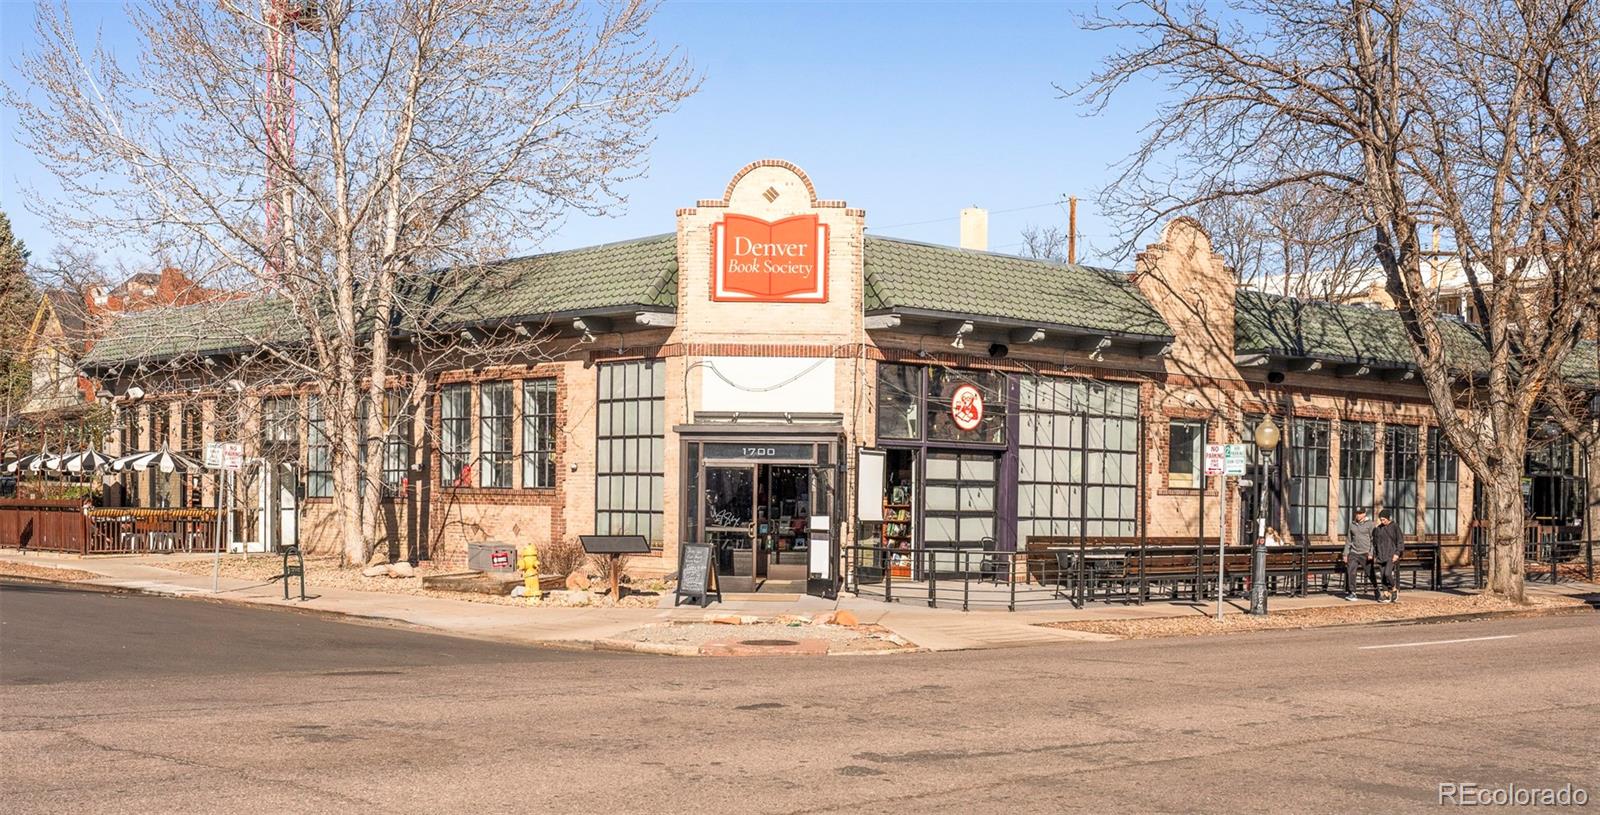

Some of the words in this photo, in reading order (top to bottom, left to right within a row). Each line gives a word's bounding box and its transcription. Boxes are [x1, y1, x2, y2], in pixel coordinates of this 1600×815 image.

[735, 236, 808, 257] Denver
[728, 258, 760, 273] Book
[763, 259, 813, 279] Society
[742, 447, 776, 456] 1700
